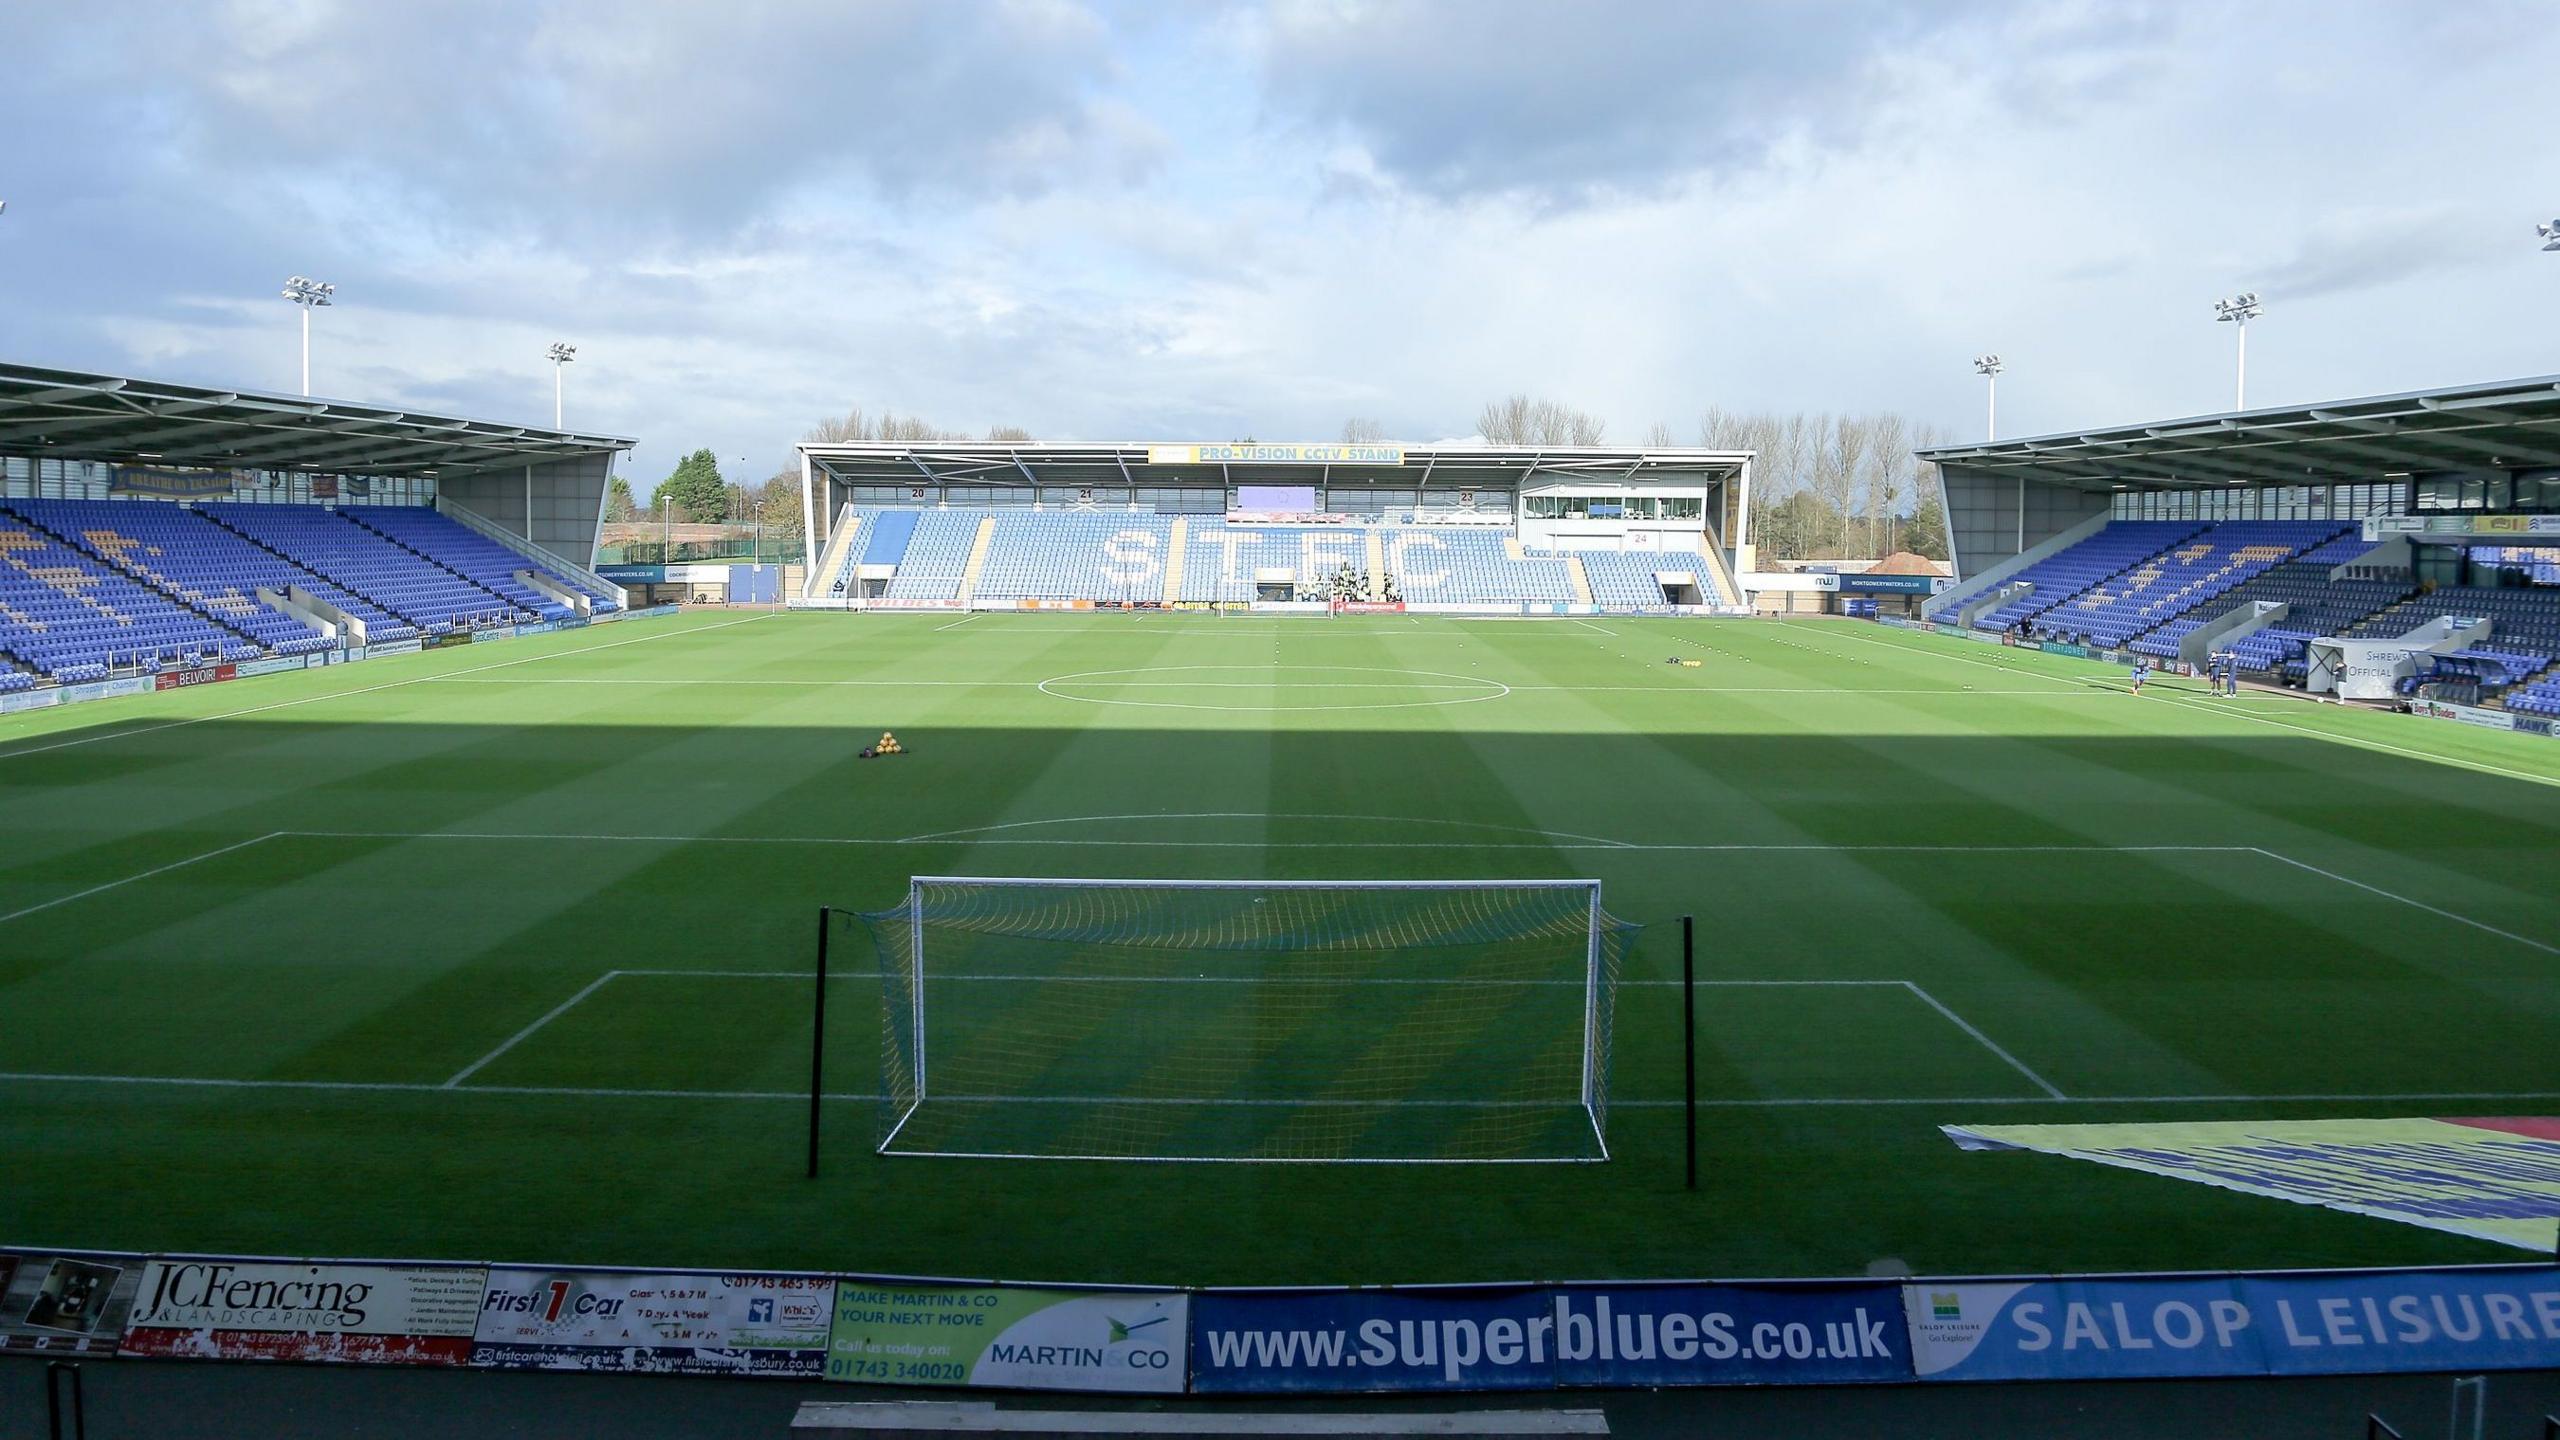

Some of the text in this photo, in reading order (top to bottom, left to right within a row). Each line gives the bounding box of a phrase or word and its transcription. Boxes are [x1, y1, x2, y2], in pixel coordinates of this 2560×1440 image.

[1200, 447, 1297, 460] PRO-VISION
[1304, 447, 1341, 460] CCTV
[1348, 447, 1399, 460] STAND
[82, 464, 93, 477] 17
[912, 489, 924, 498] 20
[1080, 489, 1092, 498] 21
[1460, 492, 1473, 501] 23
[1634, 534, 1647, 543] 24
[869, 599, 938, 608] WILDES
[1600, 604, 1637, 613] MORRIS
[1638, 604, 1675, 613] MORRIS
[2148, 658, 2159, 669] BET
[2177, 663, 2189, 674] BET
[179, 668, 216, 686] BELVOIR!
[2349, 666, 2393, 678] OFFICIAL
[2515, 717, 2550, 735] HAWK
[630, 1289, 655, 1299] Clas
[842, 1290, 998, 1308] MAKE MARTIN & CO
[483, 1280, 625, 1323] First 1 Car
[158, 1308, 337, 1327] & LANDSCAPING
[645, 1310, 669, 1319] Dys
[840, 1309, 984, 1327] YOUR NEXT MOVE
[2011, 1290, 2560, 1351] SALOP LEISURE
[1919, 1324, 1944, 1332] SALOP
[226, 1331, 256, 1342] 0143
[1207, 1296, 1892, 1381] www.superblues.co.uk
[1928, 1332, 1974, 1344] Go Explore!
[835, 1338, 864, 1353] Call
[866, 1341, 882, 1353] us
[885, 1342, 925, 1358] today
[928, 1345, 950, 1356] on:
[991, 1344, 1103, 1368] MARTIN
[1127, 1350, 1170, 1369] CO
[830, 1359, 965, 1380] 01743 340020
